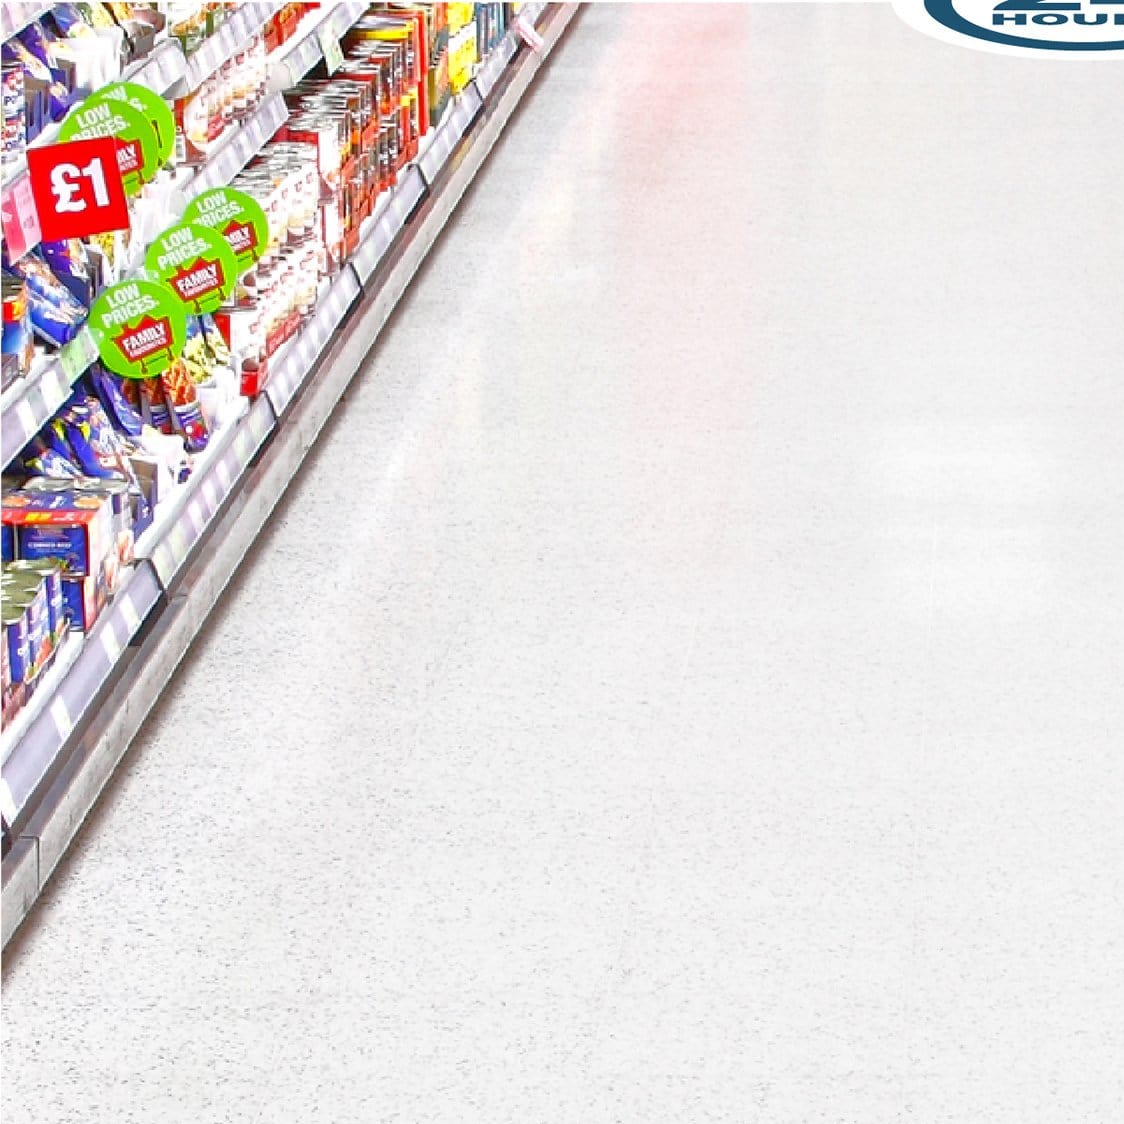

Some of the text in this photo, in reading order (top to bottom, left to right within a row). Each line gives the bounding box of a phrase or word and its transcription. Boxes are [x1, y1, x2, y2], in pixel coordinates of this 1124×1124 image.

[76, 102, 111, 129] LOW
[51, 158, 110, 213] £1
[196, 191, 227, 213] LOW
[161, 227, 193, 252] LOW
[176, 263, 217, 291] FAMILY
[106, 283, 140, 309] LOW
[122, 322, 165, 352] FAMILY
